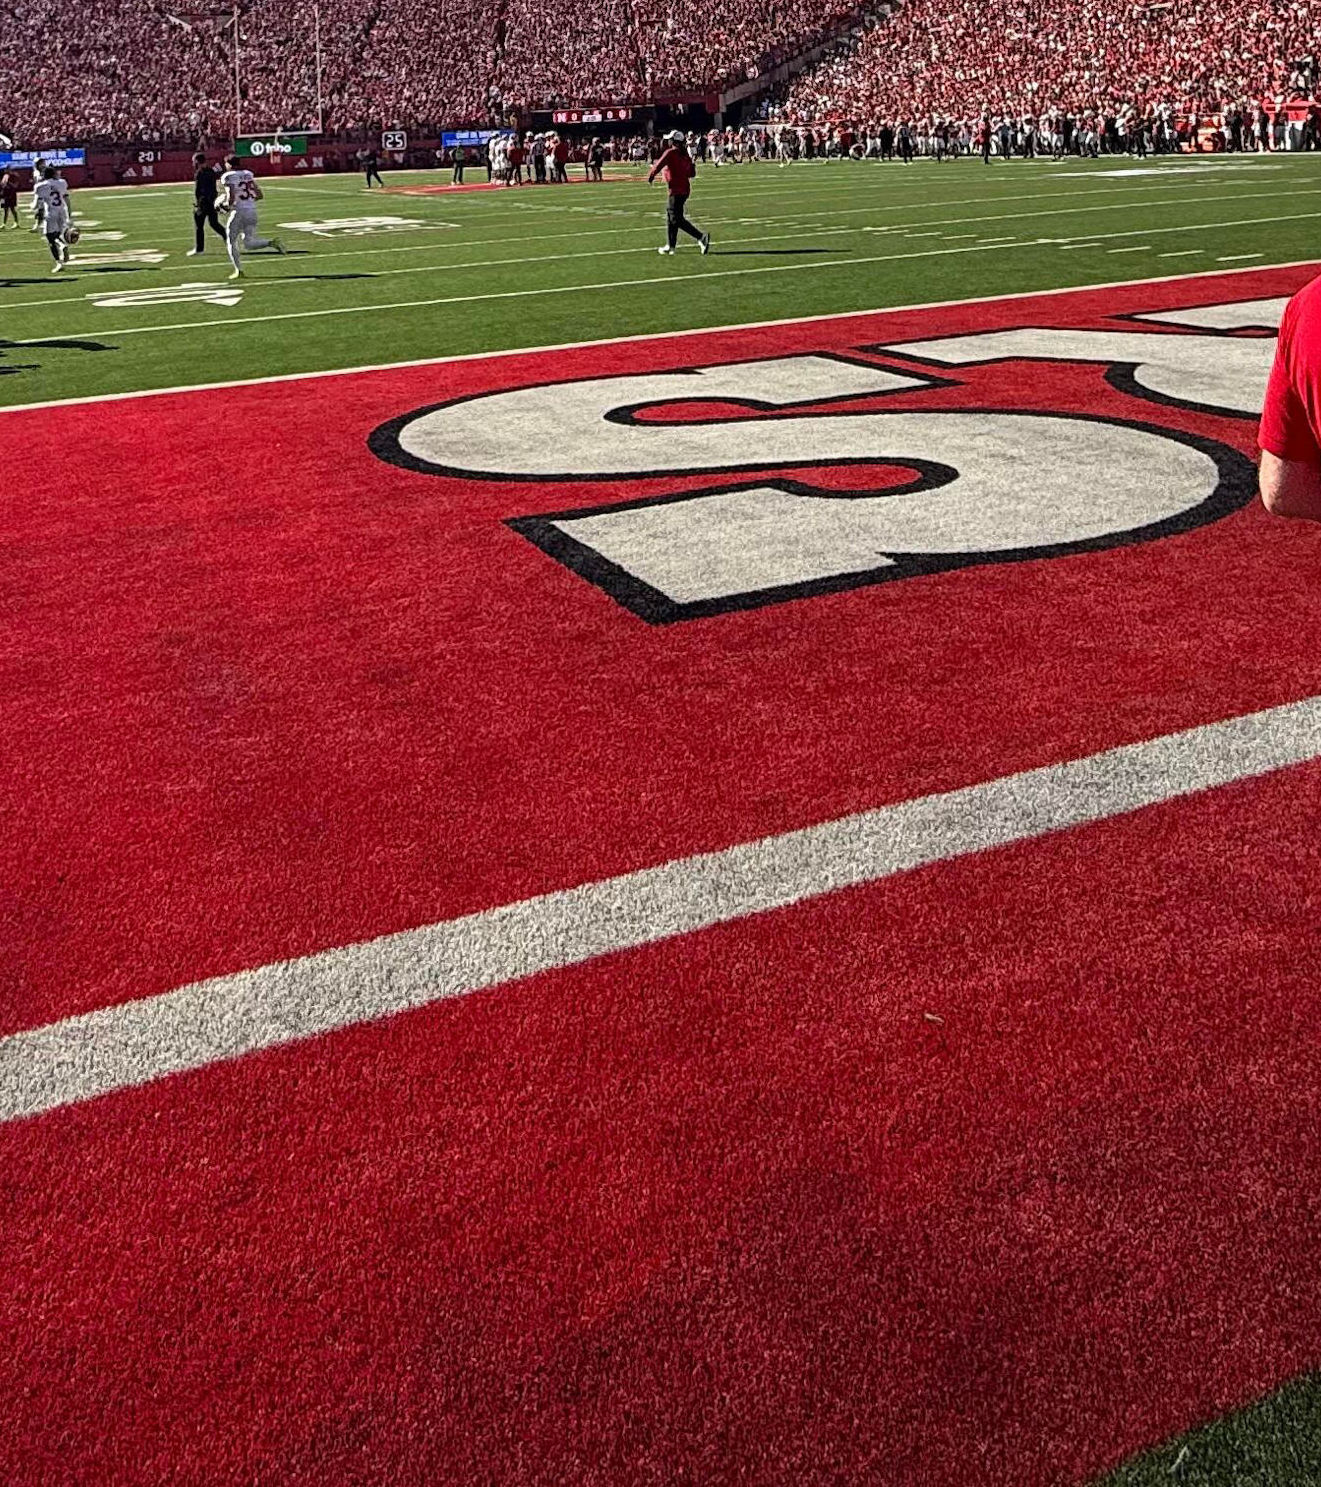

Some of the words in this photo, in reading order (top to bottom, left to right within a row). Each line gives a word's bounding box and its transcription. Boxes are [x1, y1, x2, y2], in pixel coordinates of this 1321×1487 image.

[385, 134, 404, 149] 25
[138, 151, 161, 163] 2:01
[51, 191, 62, 207] 3
